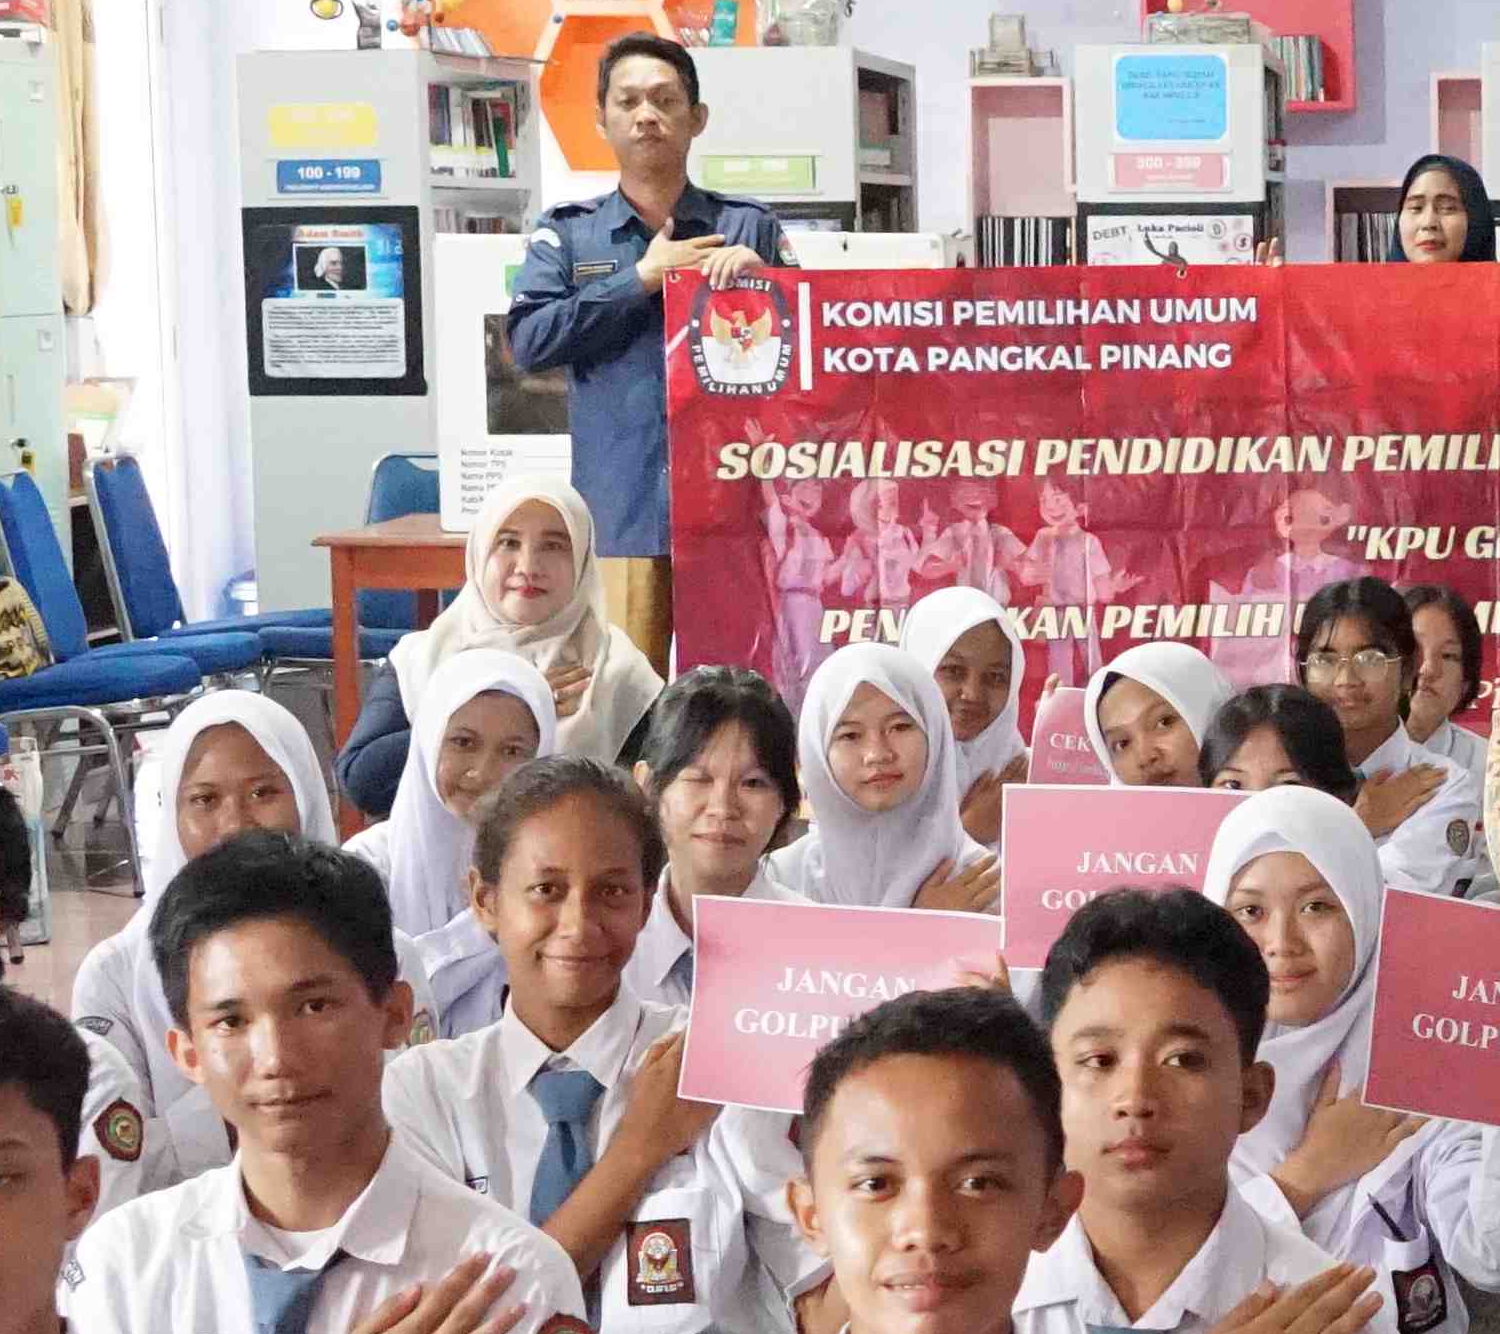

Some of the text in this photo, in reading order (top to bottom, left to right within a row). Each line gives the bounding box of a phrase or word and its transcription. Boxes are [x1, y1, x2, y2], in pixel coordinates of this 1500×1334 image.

[297, 167, 323, 179] 100
[335, 166, 362, 179] 199
[1092, 225, 1127, 241] DEBT
[822, 296, 1258, 328] KOMISI PEMILIHAN UMUM
[822, 342, 1232, 373] KOTA PANGKAL PINANG
[716, 439, 1027, 480] SOSIALISASI
[1033, 434, 1333, 477] PENDIDIKAN
[1346, 524, 1454, 562] "KPU
[1100, 601, 1285, 639] PEMILIH
[1076, 850, 1198, 875] JANGAN
[777, 967, 916, 1001] JANGAN
